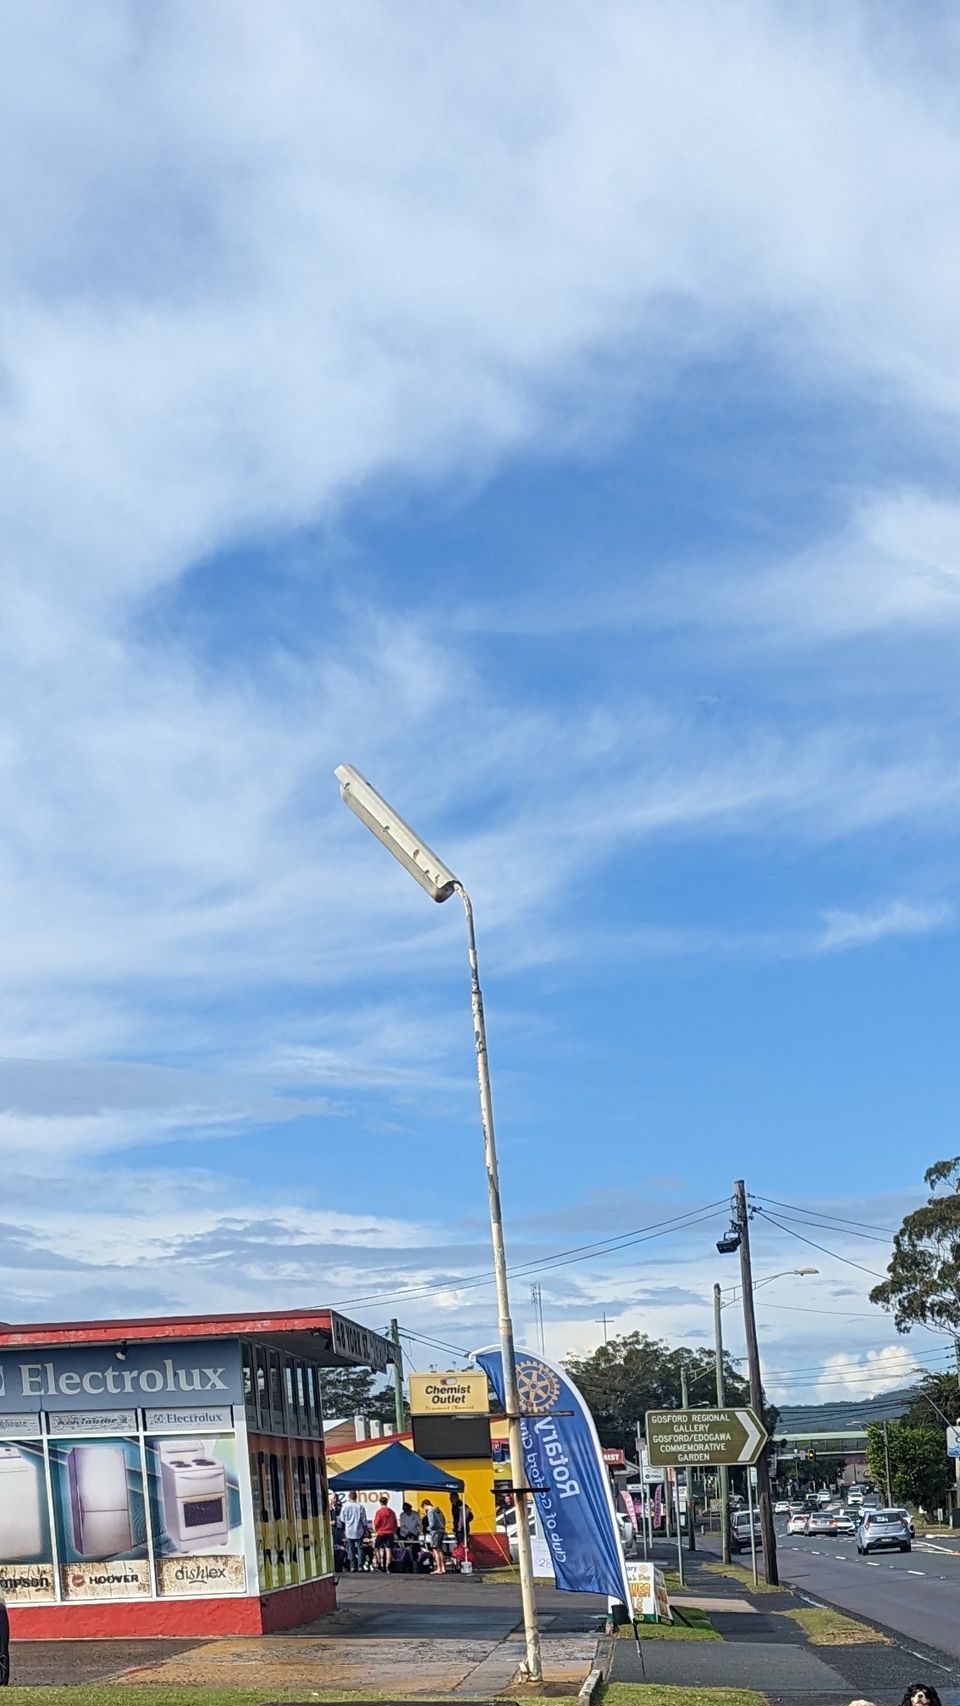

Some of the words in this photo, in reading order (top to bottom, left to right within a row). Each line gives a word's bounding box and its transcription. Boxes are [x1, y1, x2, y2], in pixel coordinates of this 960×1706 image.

[18, 1359, 229, 1396] Electrolux
[425, 1385, 471, 1395] Chemist
[431, 1395, 466, 1404] Outlet
[167, 1412, 223, 1424] Electrolux
[651, 1414, 688, 1424] GOSFORD
[691, 1413, 730, 1422] REGIONAL
[673, 1424, 710, 1433] GALLERY
[652, 1433, 732, 1443] GOSFORD/EDOGAWA
[660, 1443, 727, 1453] COMMEMORATIVE
[677, 1453, 710, 1462] GARDEN
[175, 1564, 227, 1582] dishlex
[89, 1573, 139, 1585] HOOVER
